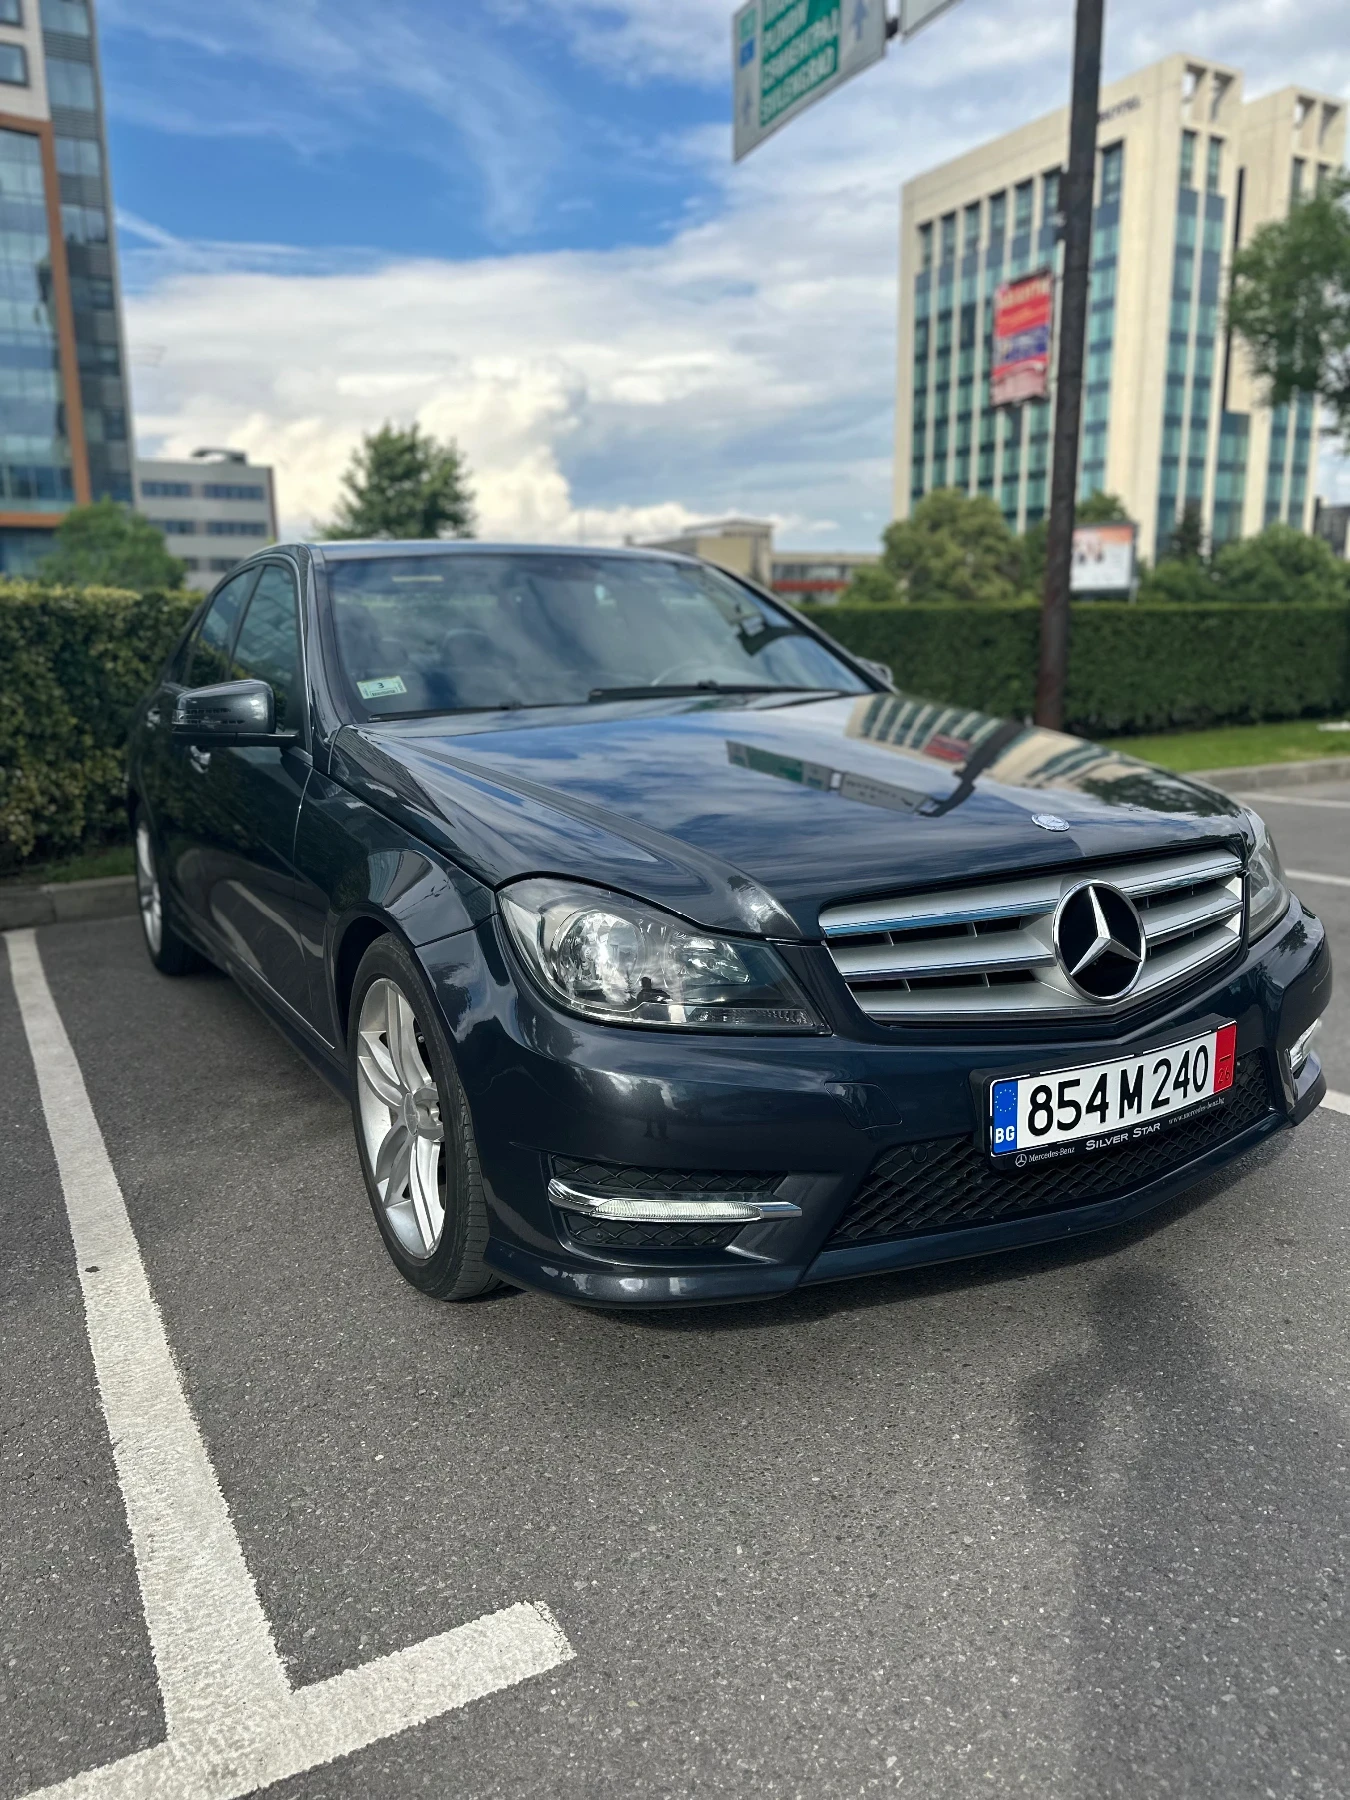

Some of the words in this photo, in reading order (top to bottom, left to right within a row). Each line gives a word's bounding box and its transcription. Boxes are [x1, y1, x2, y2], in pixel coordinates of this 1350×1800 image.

[995, 1125, 1015, 1144] BG
[1085, 1132, 1129, 1151] SILVER
[1132, 1122, 1161, 1138] STAR
[1028, 1146, 1076, 1163] Mercedes-Benz
